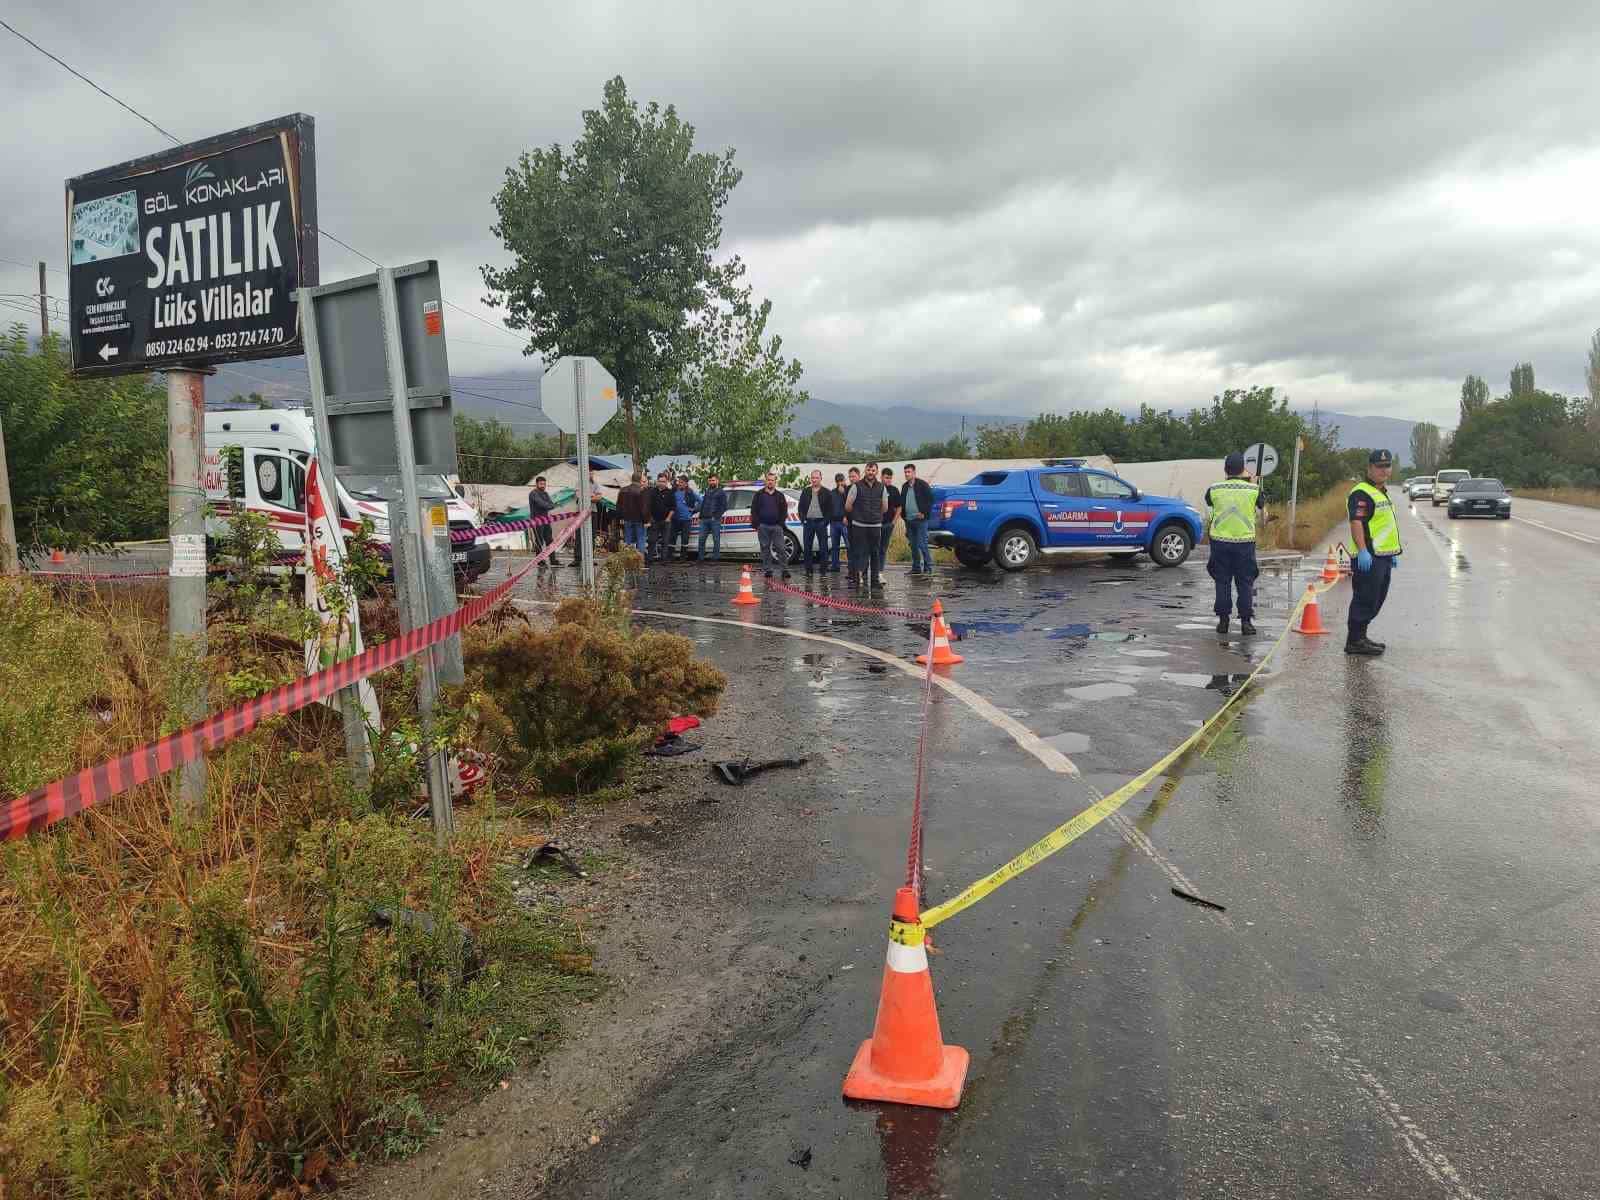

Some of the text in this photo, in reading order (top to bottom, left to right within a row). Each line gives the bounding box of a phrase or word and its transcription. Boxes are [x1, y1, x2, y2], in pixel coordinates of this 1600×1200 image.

[144, 167, 285, 215] GÖL KONAKLARI
[145, 200, 283, 289] SATILIK
[154, 280, 274, 329] Lüks Villalar
[145, 341, 166, 357] 0850
[166, 339, 182, 355] 224
[184, 337, 196, 353] 62
[197, 335, 209, 351] 94
[215, 332, 237, 349] 0532
[239, 330, 256, 347] 724
[258, 328, 270, 344] 74
[271, 326, 284, 343] 70
[1047, 511, 1089, 521] JANDARMA
